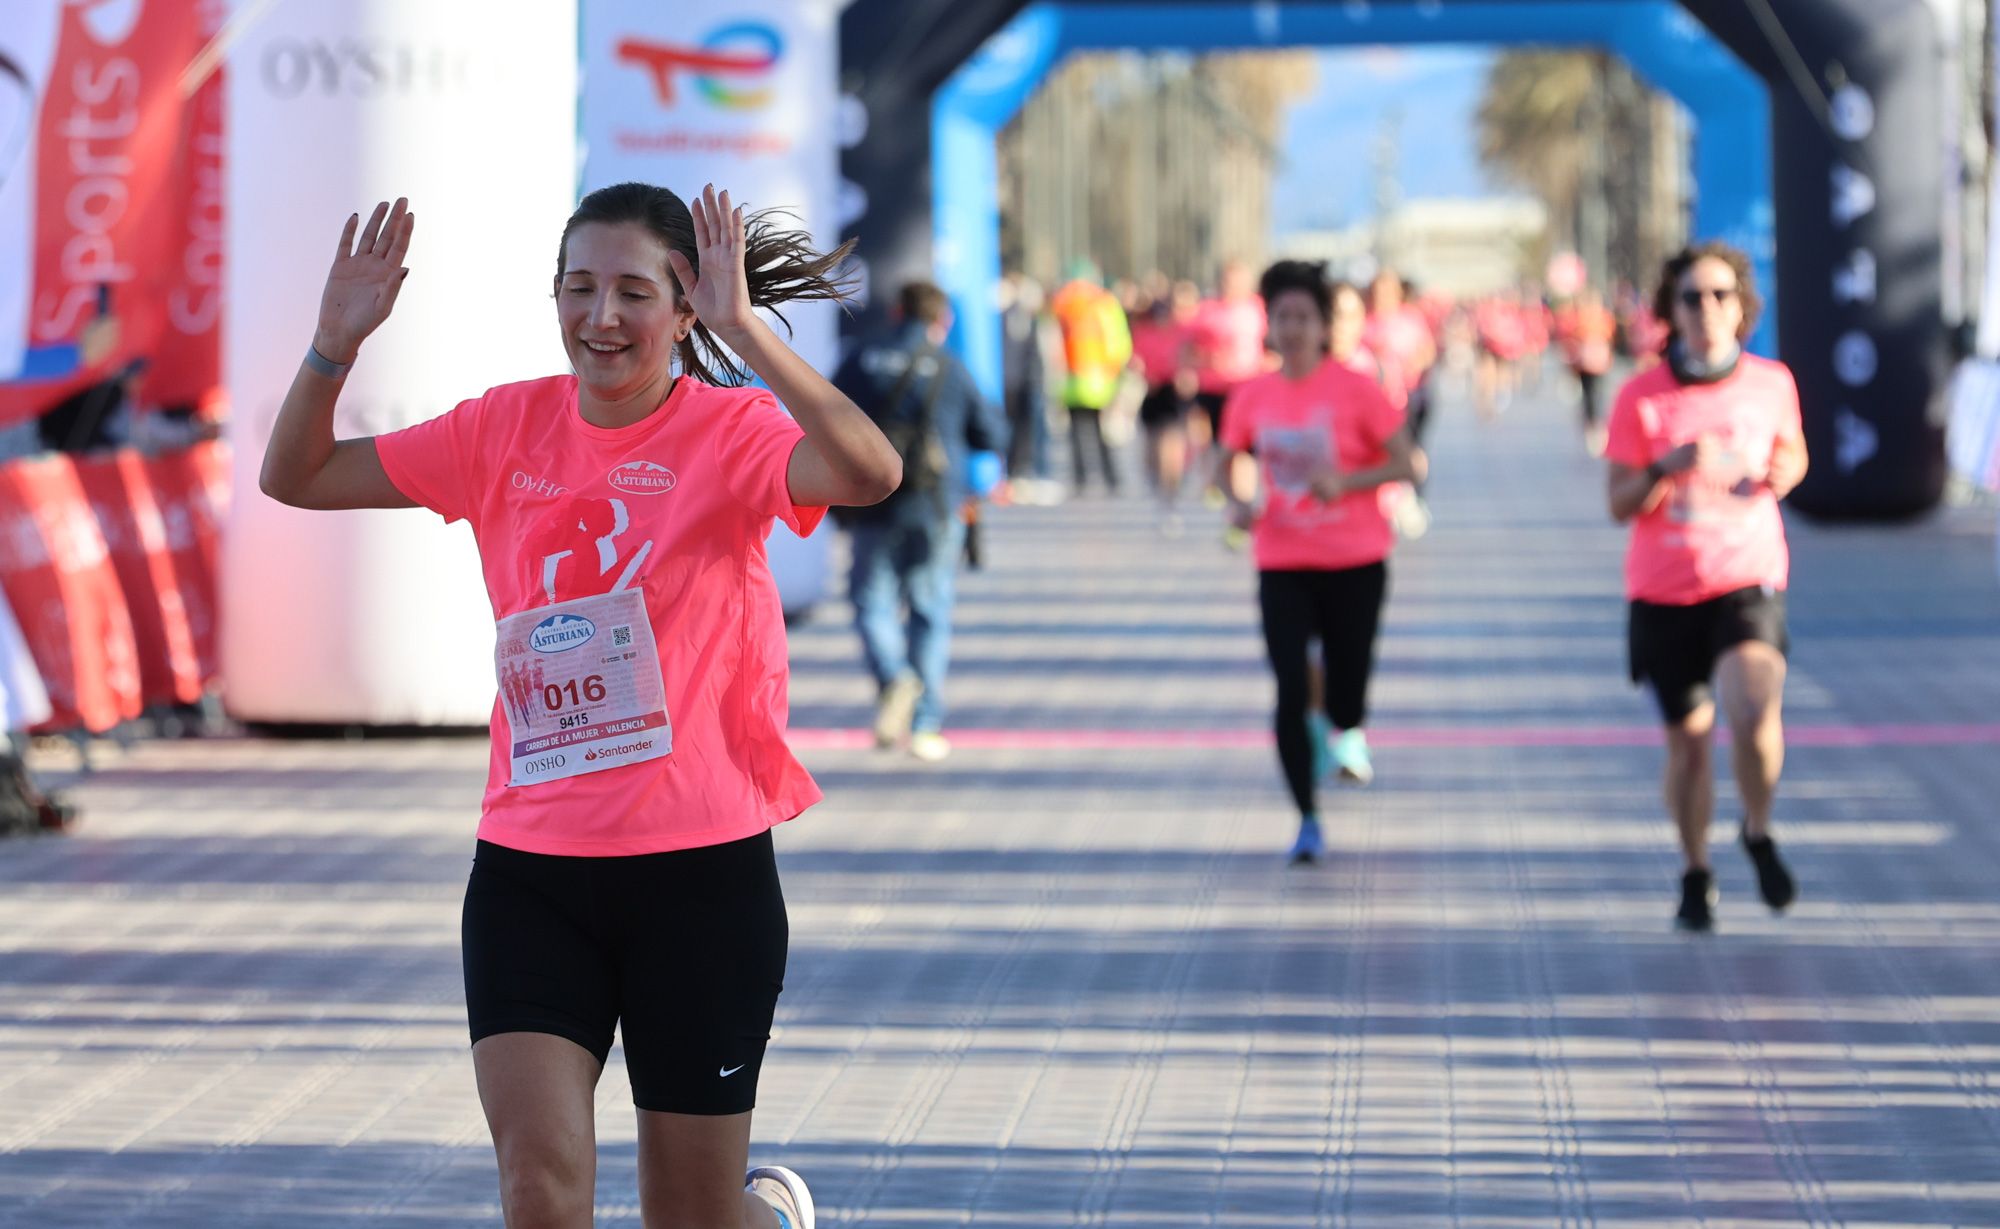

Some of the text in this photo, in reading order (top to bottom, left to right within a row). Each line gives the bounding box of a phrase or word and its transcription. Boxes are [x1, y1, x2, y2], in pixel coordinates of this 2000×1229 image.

[33, 56, 140, 339] Sports
[613, 472, 671, 487] ASTURIANA
[534, 627, 591, 648] ASTURIANA
[543, 674, 607, 711] 016
[560, 712, 589, 729] 9415
[525, 719, 646, 752] CARRERA DE LA MUJER VALENCIA
[598, 740, 653, 759] Santander
[525, 754, 566, 775] OYSHO
